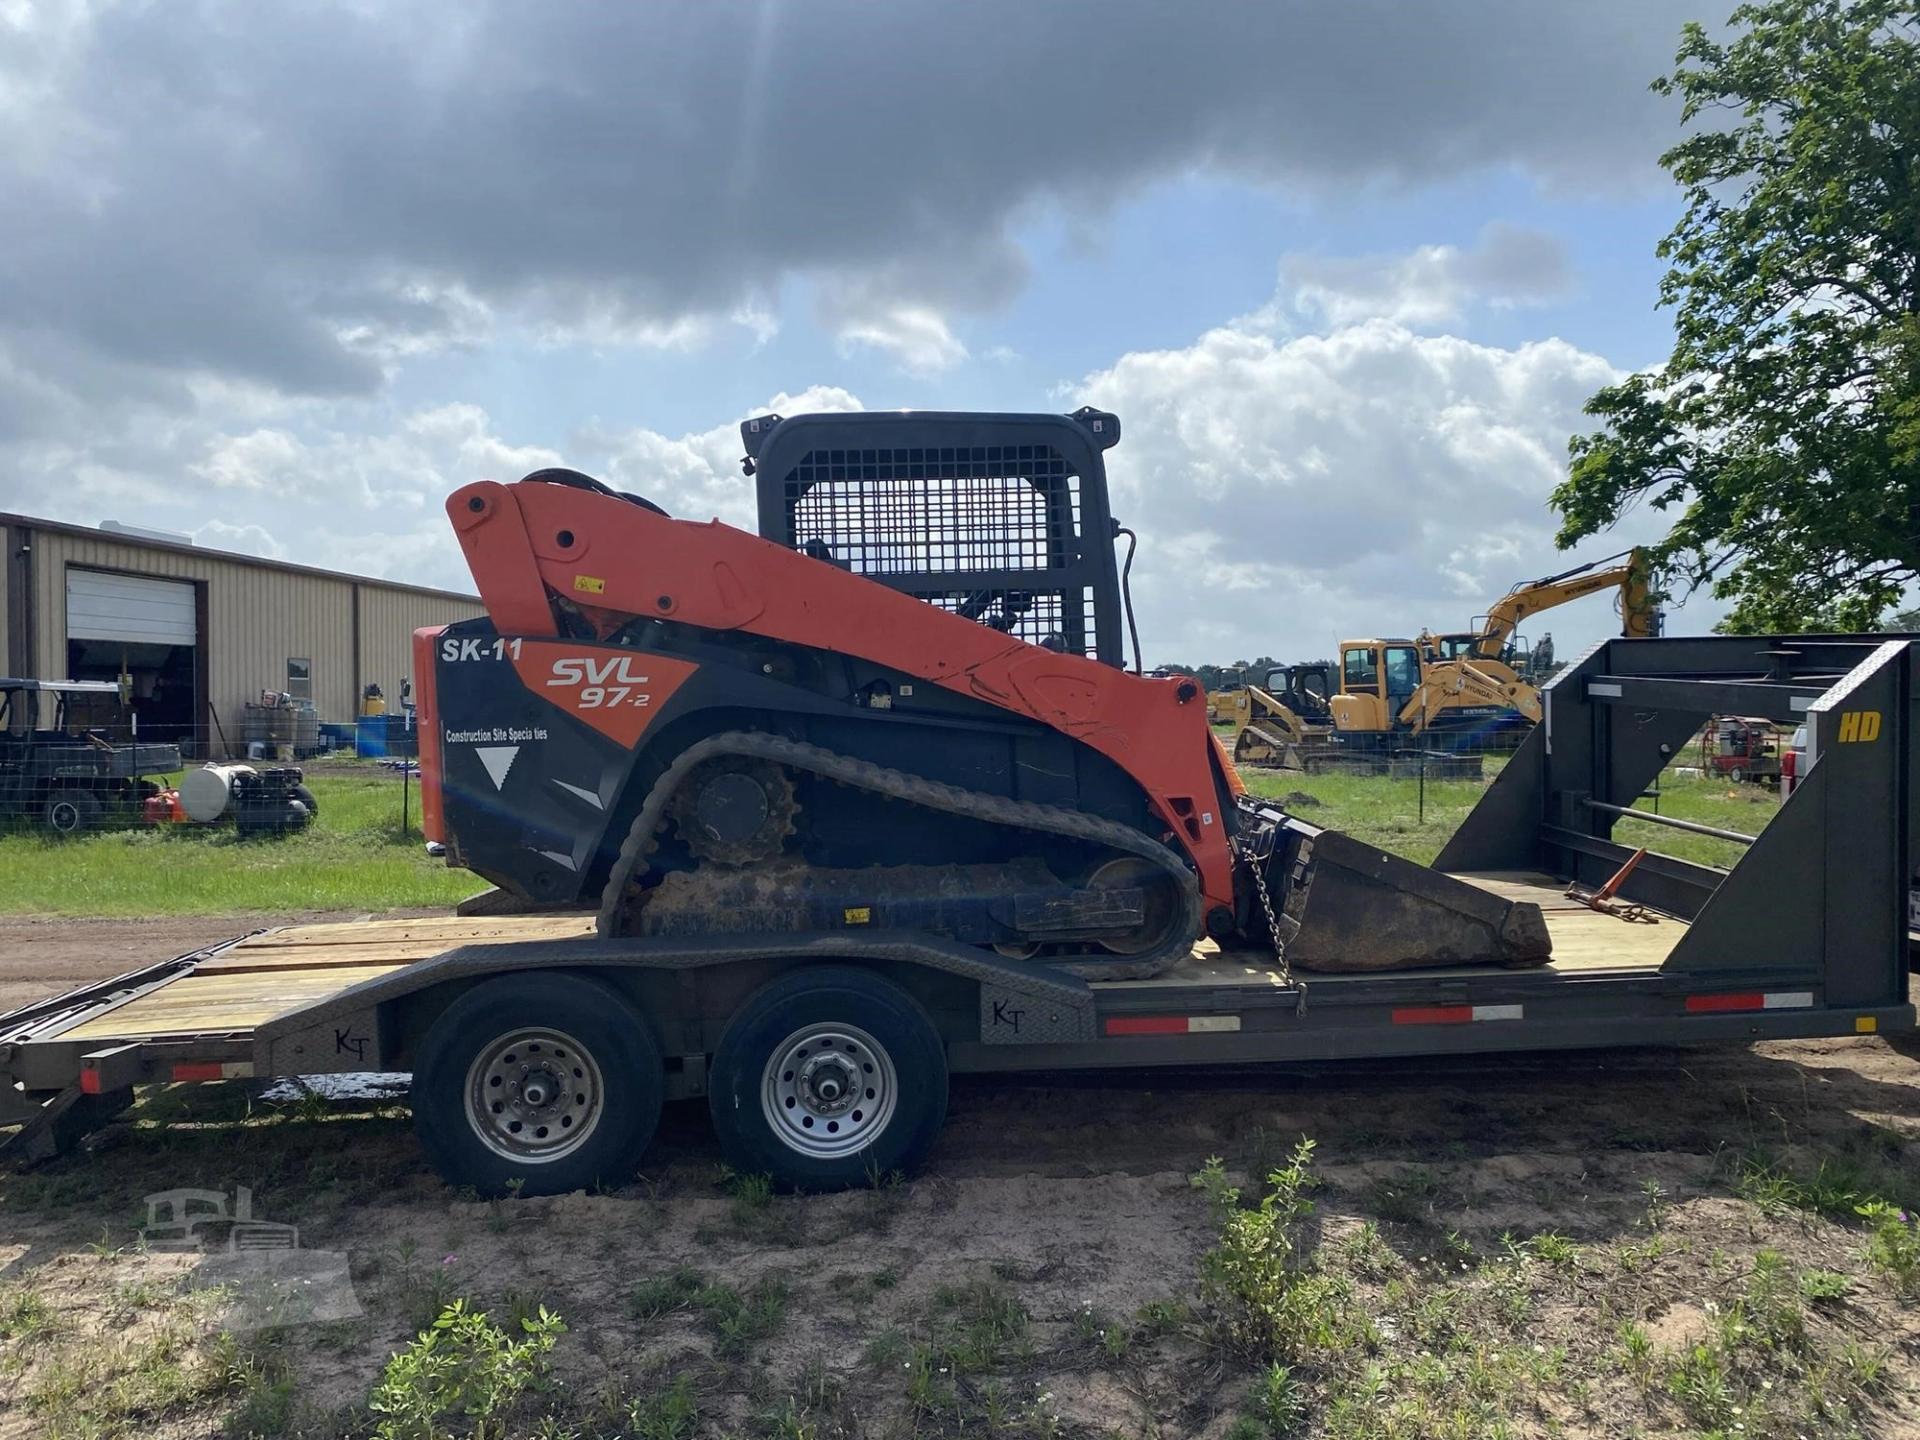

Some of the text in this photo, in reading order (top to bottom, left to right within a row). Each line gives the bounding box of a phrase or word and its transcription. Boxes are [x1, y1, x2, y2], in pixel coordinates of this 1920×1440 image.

[441, 637, 522, 662] SK-11
[546, 657, 649, 686] SVL
[578, 687, 650, 708] 97-2
[446, 729, 491, 742] Construction
[492, 728, 507, 741] Site
[1837, 711, 1881, 743] HD
